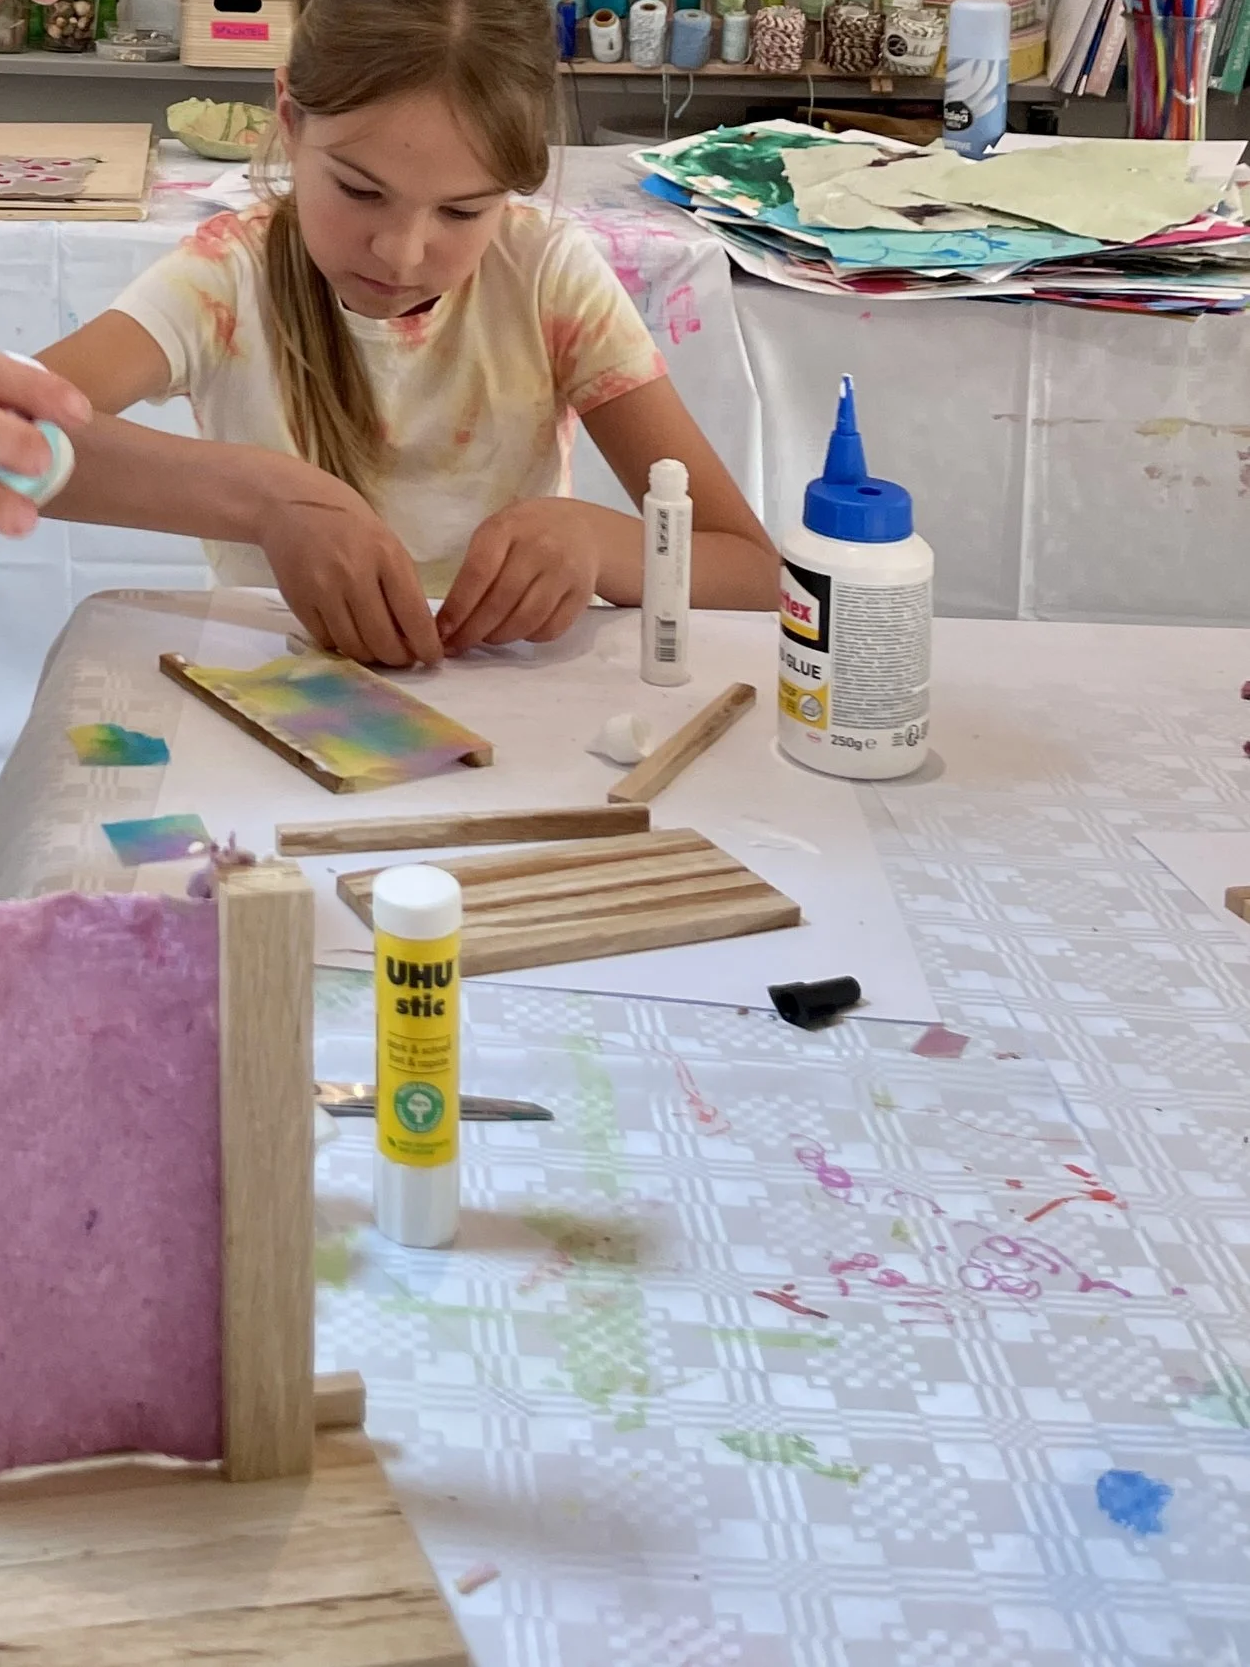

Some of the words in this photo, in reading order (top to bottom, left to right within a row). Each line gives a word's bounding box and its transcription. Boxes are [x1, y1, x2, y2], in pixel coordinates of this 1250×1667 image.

[787, 655, 823, 680] GLUE
[386, 956, 453, 990] UHU
[396, 994, 445, 1018] stic
